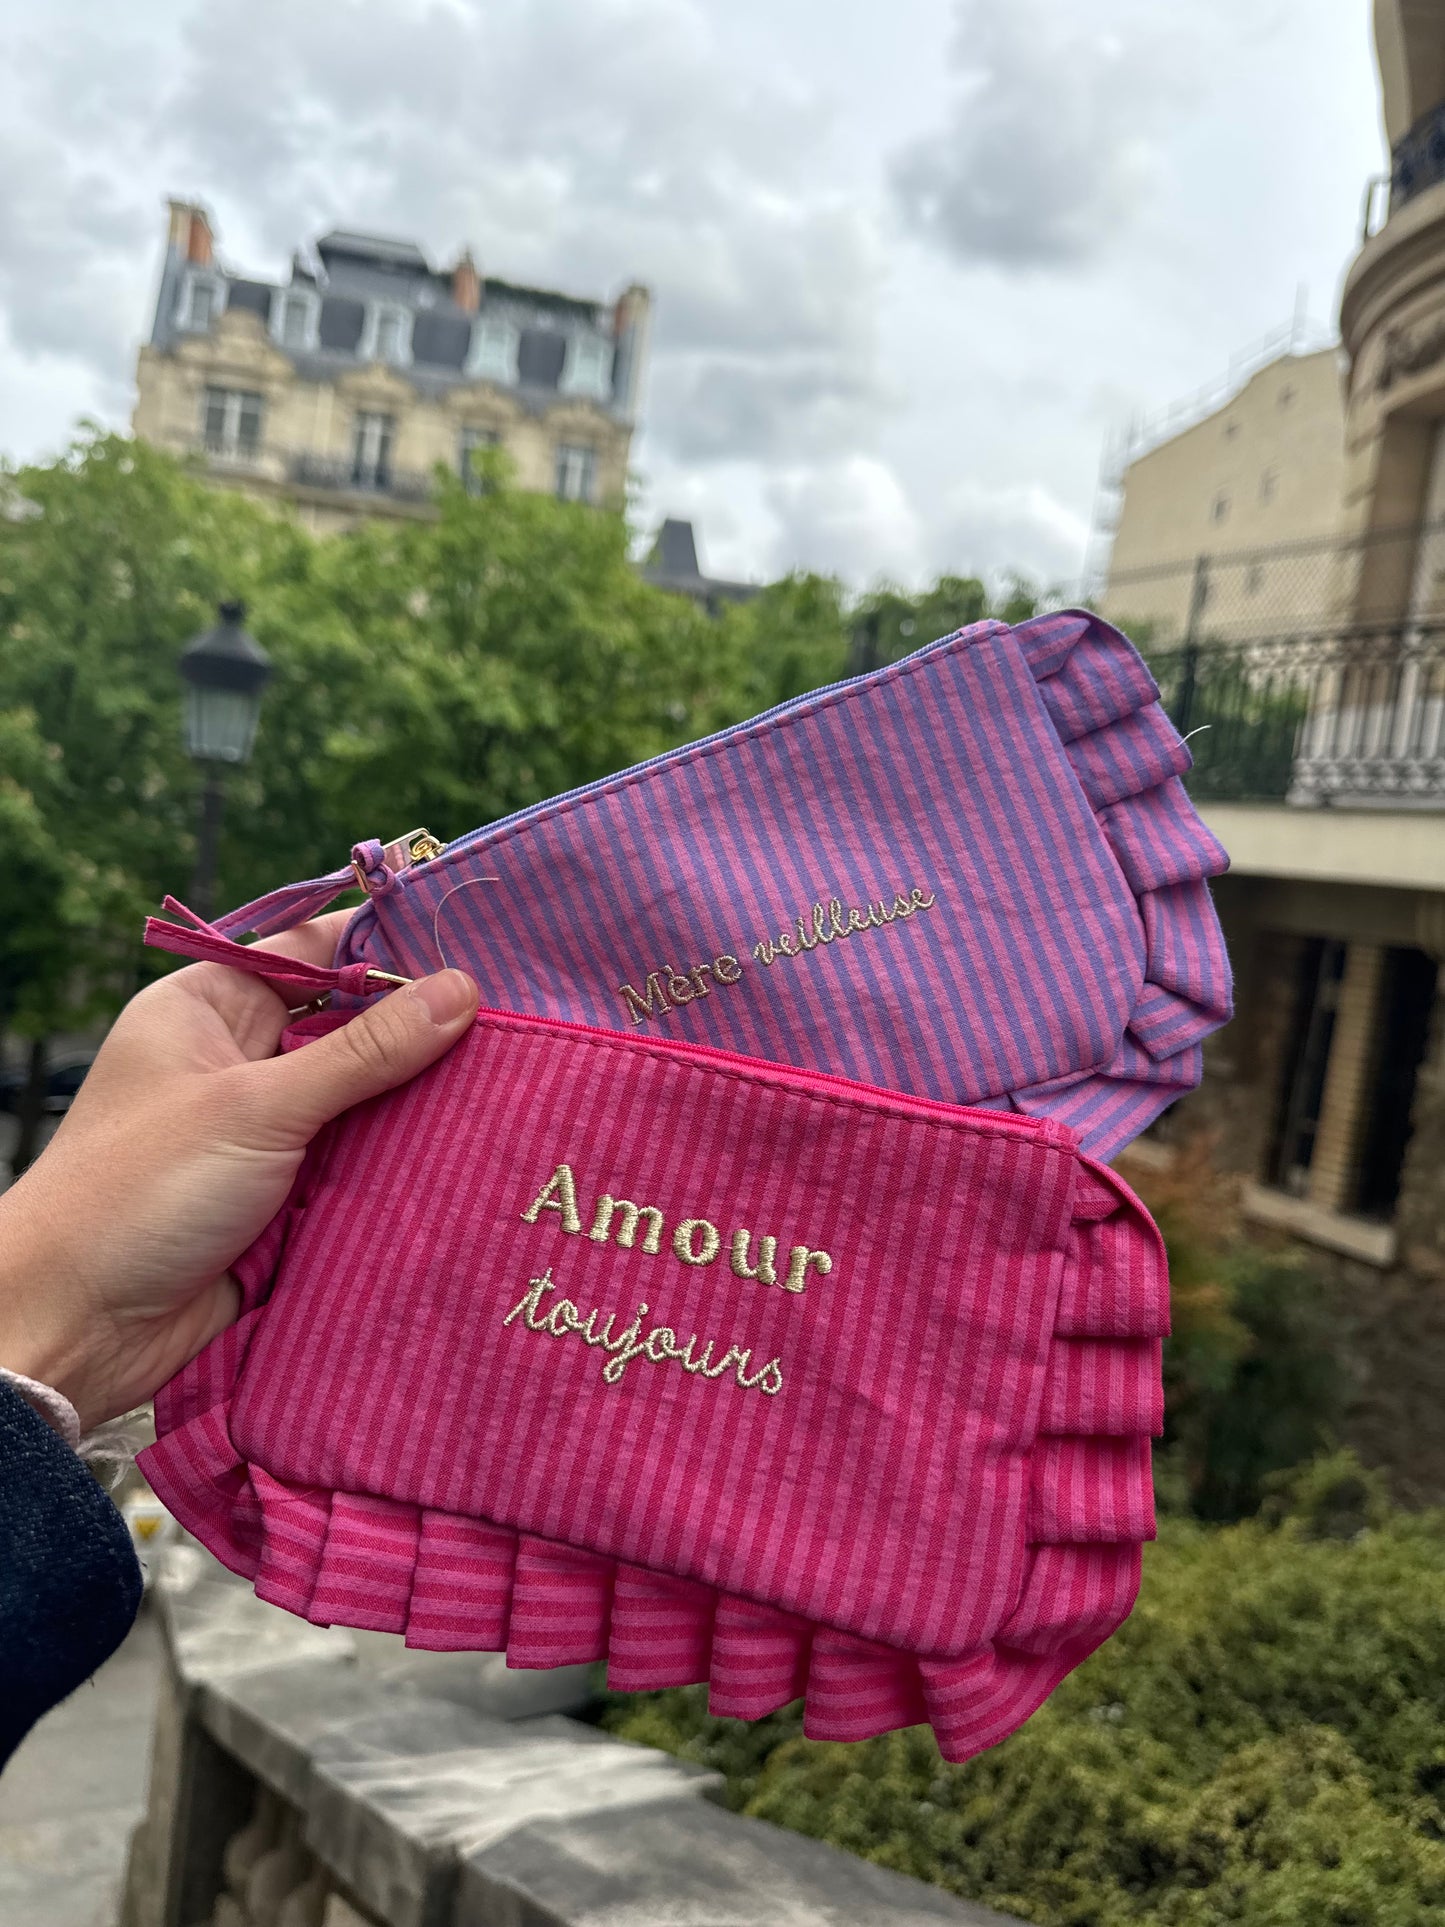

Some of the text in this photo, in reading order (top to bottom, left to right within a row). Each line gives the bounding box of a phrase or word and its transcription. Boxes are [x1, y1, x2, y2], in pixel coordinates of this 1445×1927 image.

[619, 888, 936, 1026] Mère veilleuse
[520, 1164, 833, 1293] Amour
[503, 1267, 783, 1395] toujours
